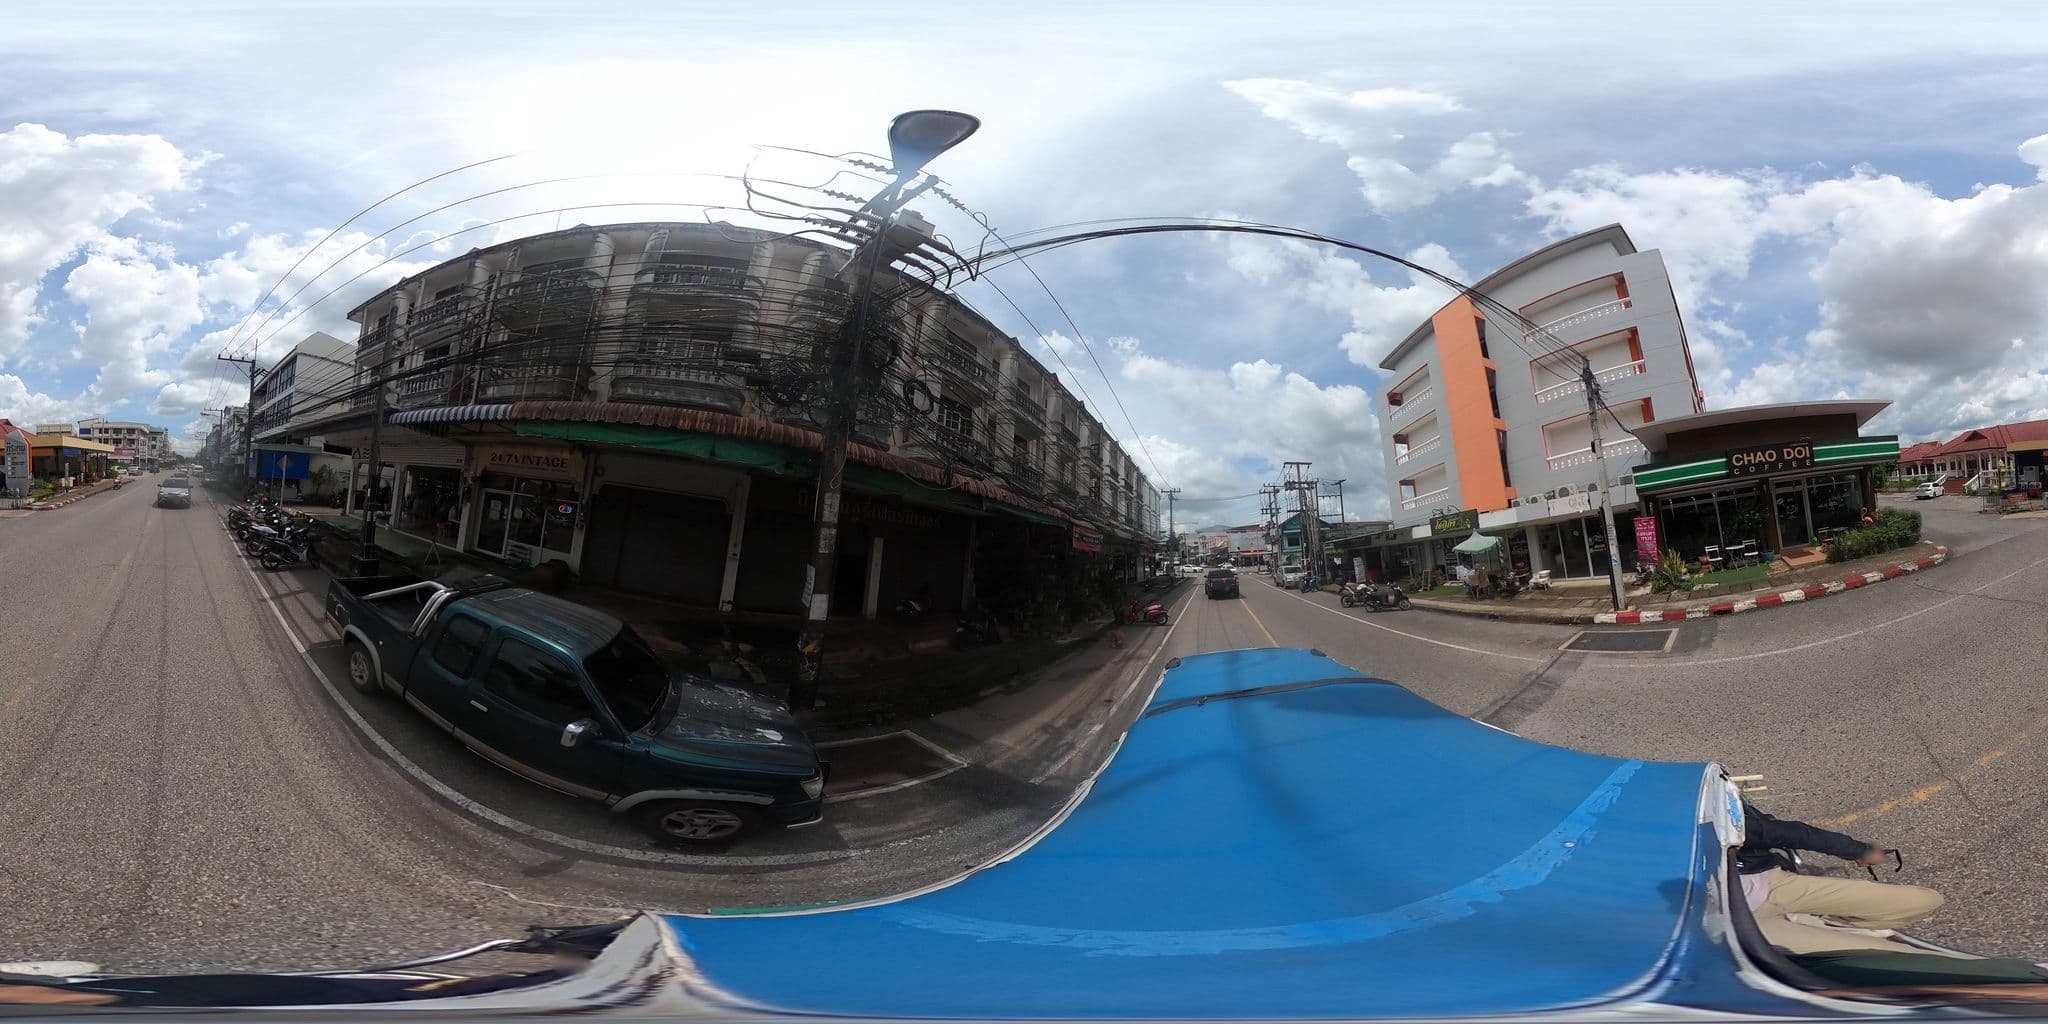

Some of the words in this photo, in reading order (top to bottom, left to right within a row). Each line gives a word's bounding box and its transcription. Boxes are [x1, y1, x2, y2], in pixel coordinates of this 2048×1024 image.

[1732, 450, 1777, 466] CHAO
[1783, 447, 1810, 460] DOI
[1734, 460, 1811, 475] COFFEE
